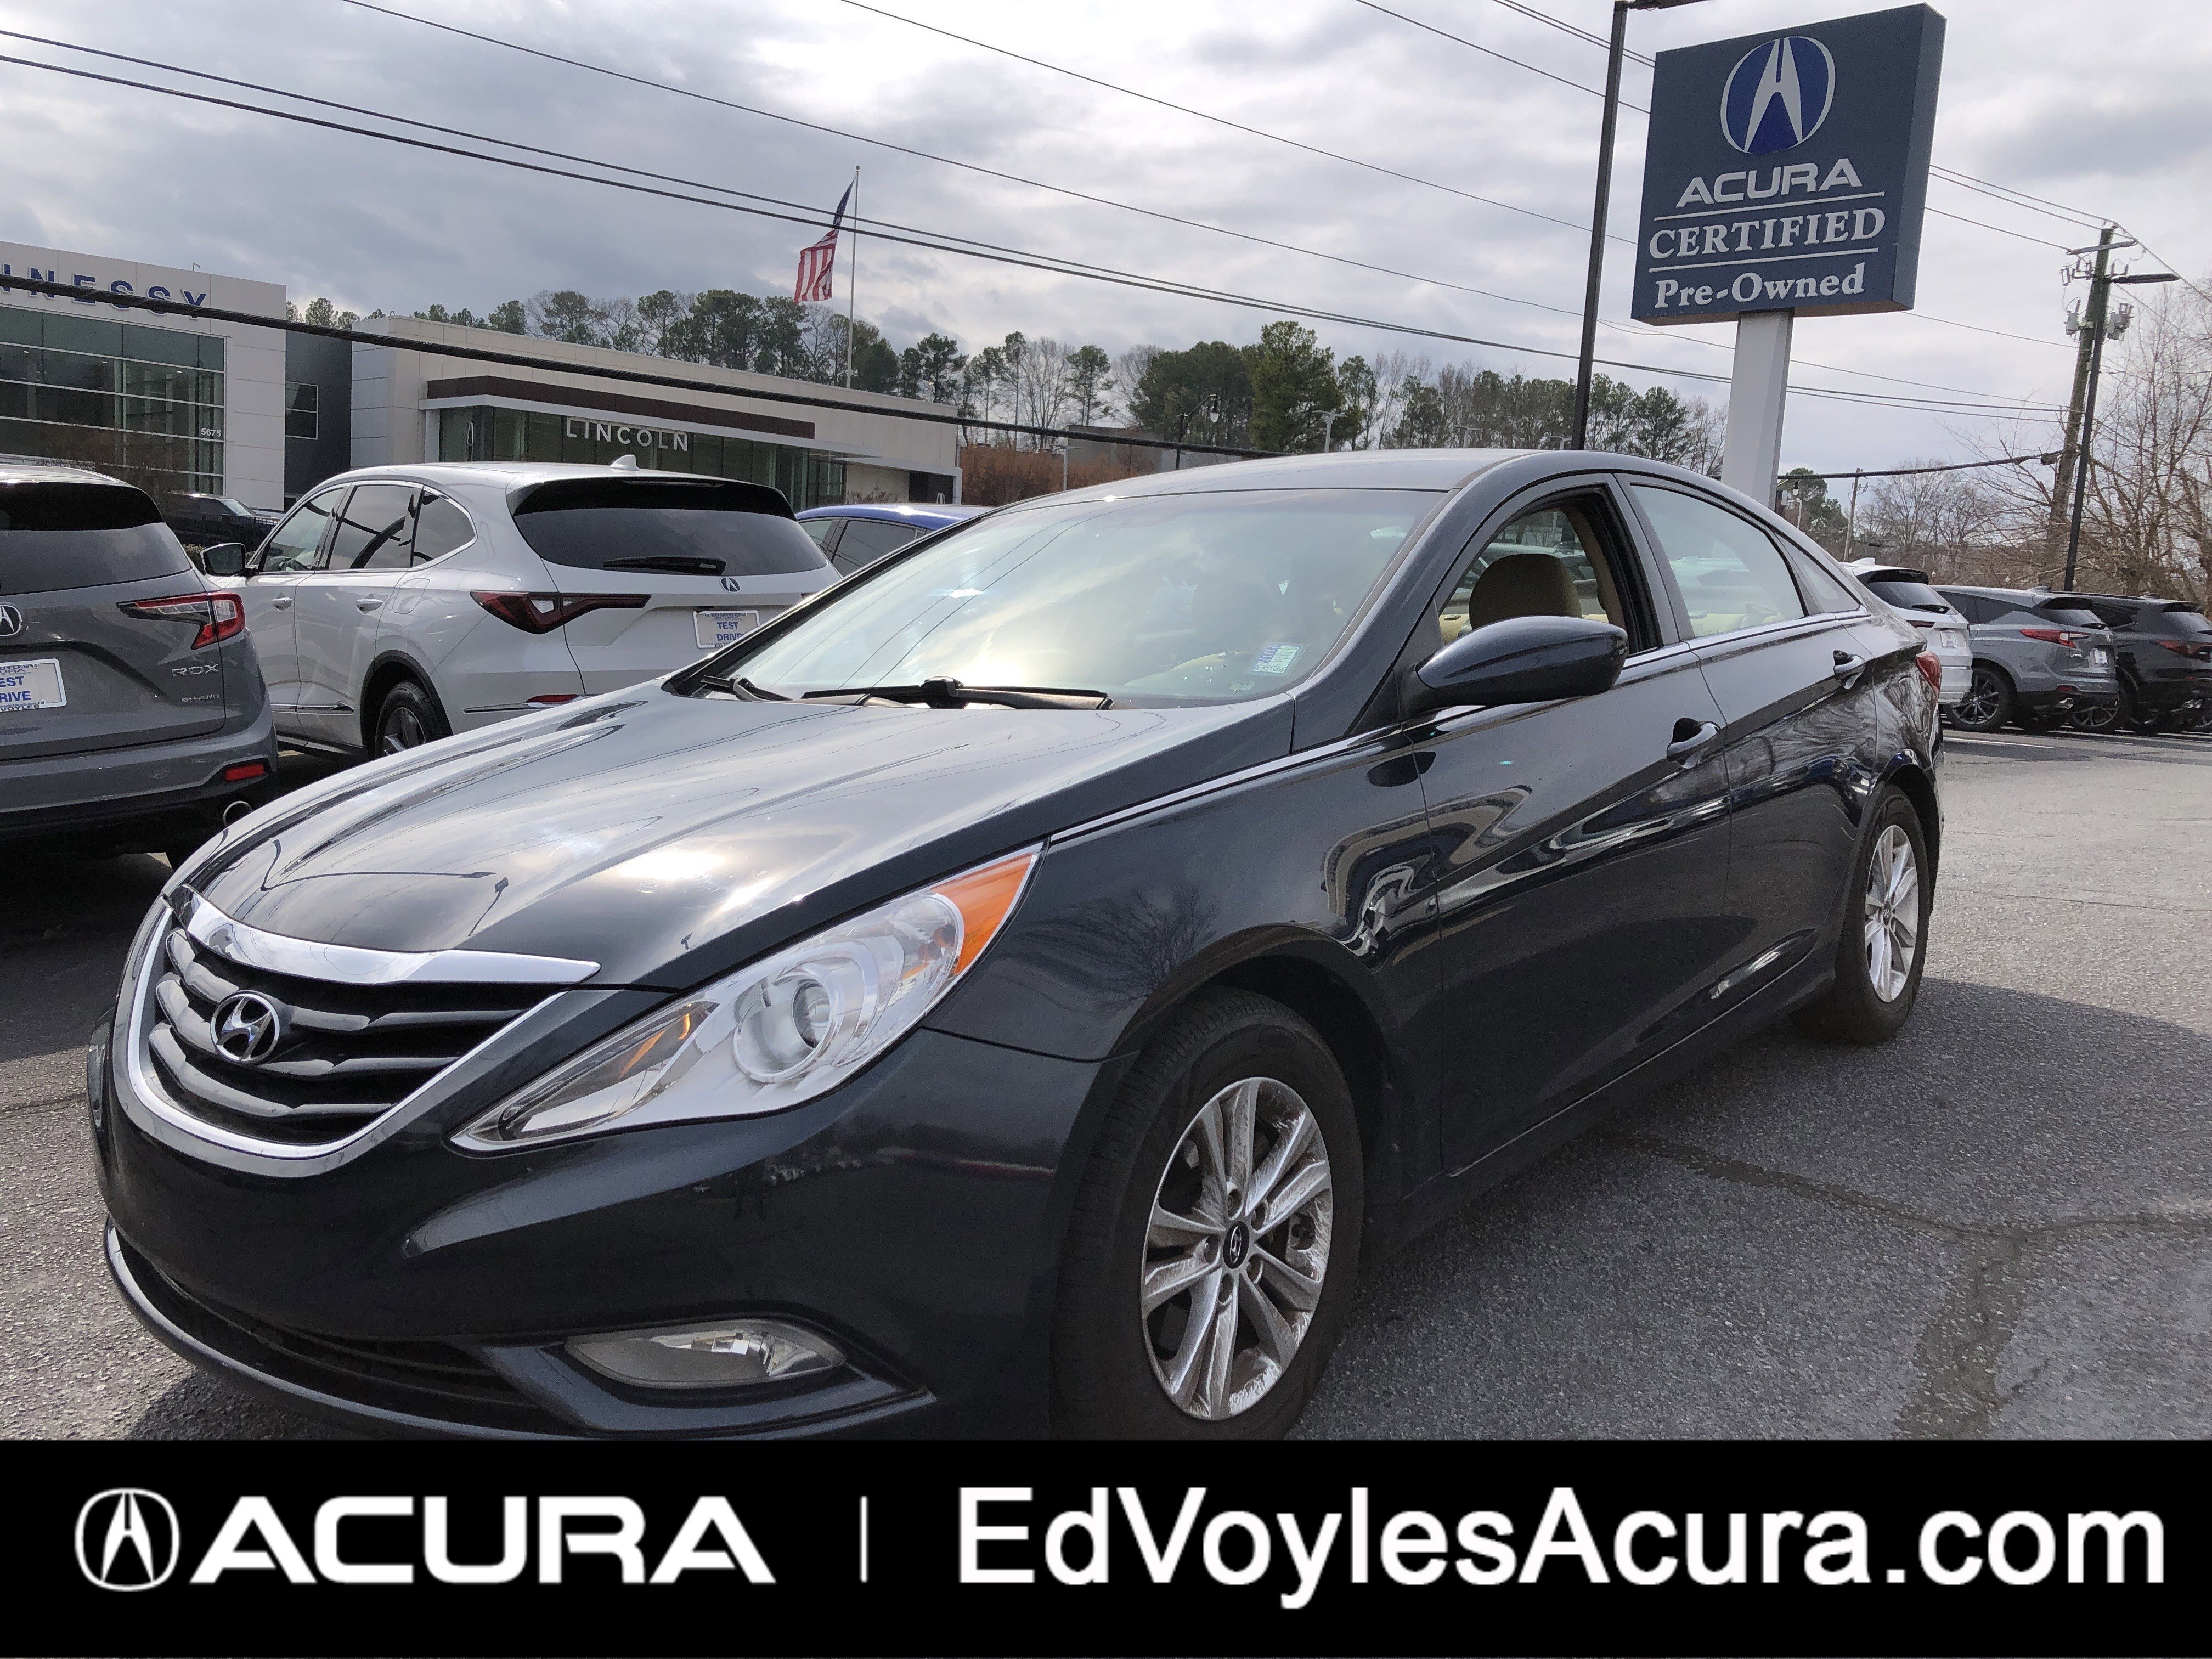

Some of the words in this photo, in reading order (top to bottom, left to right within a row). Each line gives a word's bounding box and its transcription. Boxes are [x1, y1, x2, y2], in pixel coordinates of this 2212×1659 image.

[1676, 157, 1863, 208] ACURA
[1649, 208, 1886, 259] CERTIFIED
[1654, 262, 1865, 309] Pre-Owned
[201, 428, 222, 437] 5675
[566, 417, 688, 452] LINCOLN
[716, 622, 739, 630] TEST
[172, 664, 219, 677] RDX
